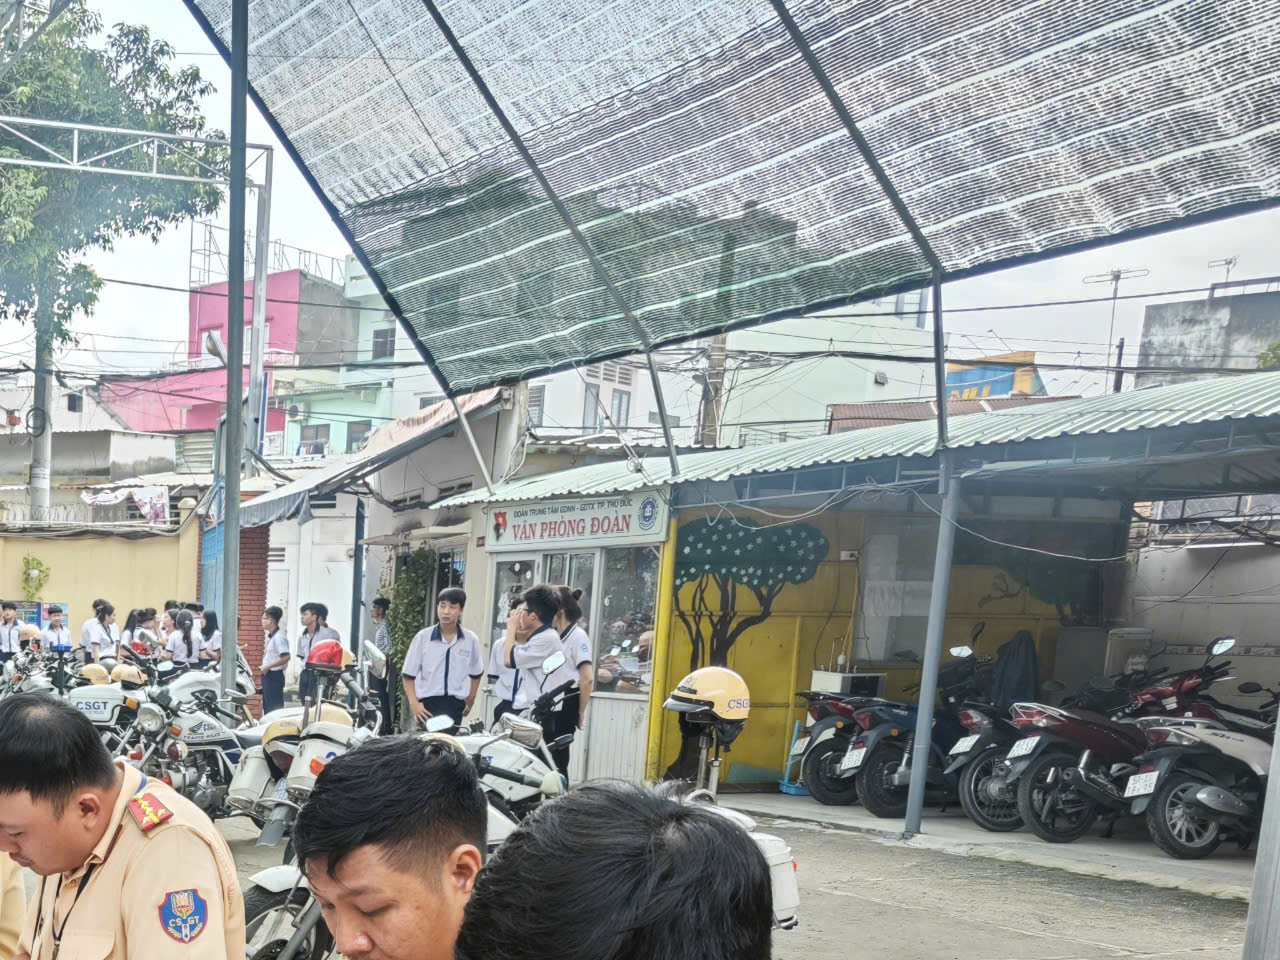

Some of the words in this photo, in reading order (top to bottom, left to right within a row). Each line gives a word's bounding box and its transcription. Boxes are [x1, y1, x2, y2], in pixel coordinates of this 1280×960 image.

[529, 507, 546, 516] TRUNG
[547, 505, 559, 514] TÂM
[512, 520, 537, 540] VĂN
[539, 515, 586, 539] PHÒNG
[590, 510, 632, 535] ĐOÀN
[76, 701, 109, 711] CSGT
[168, 915, 200, 927] CSGT
